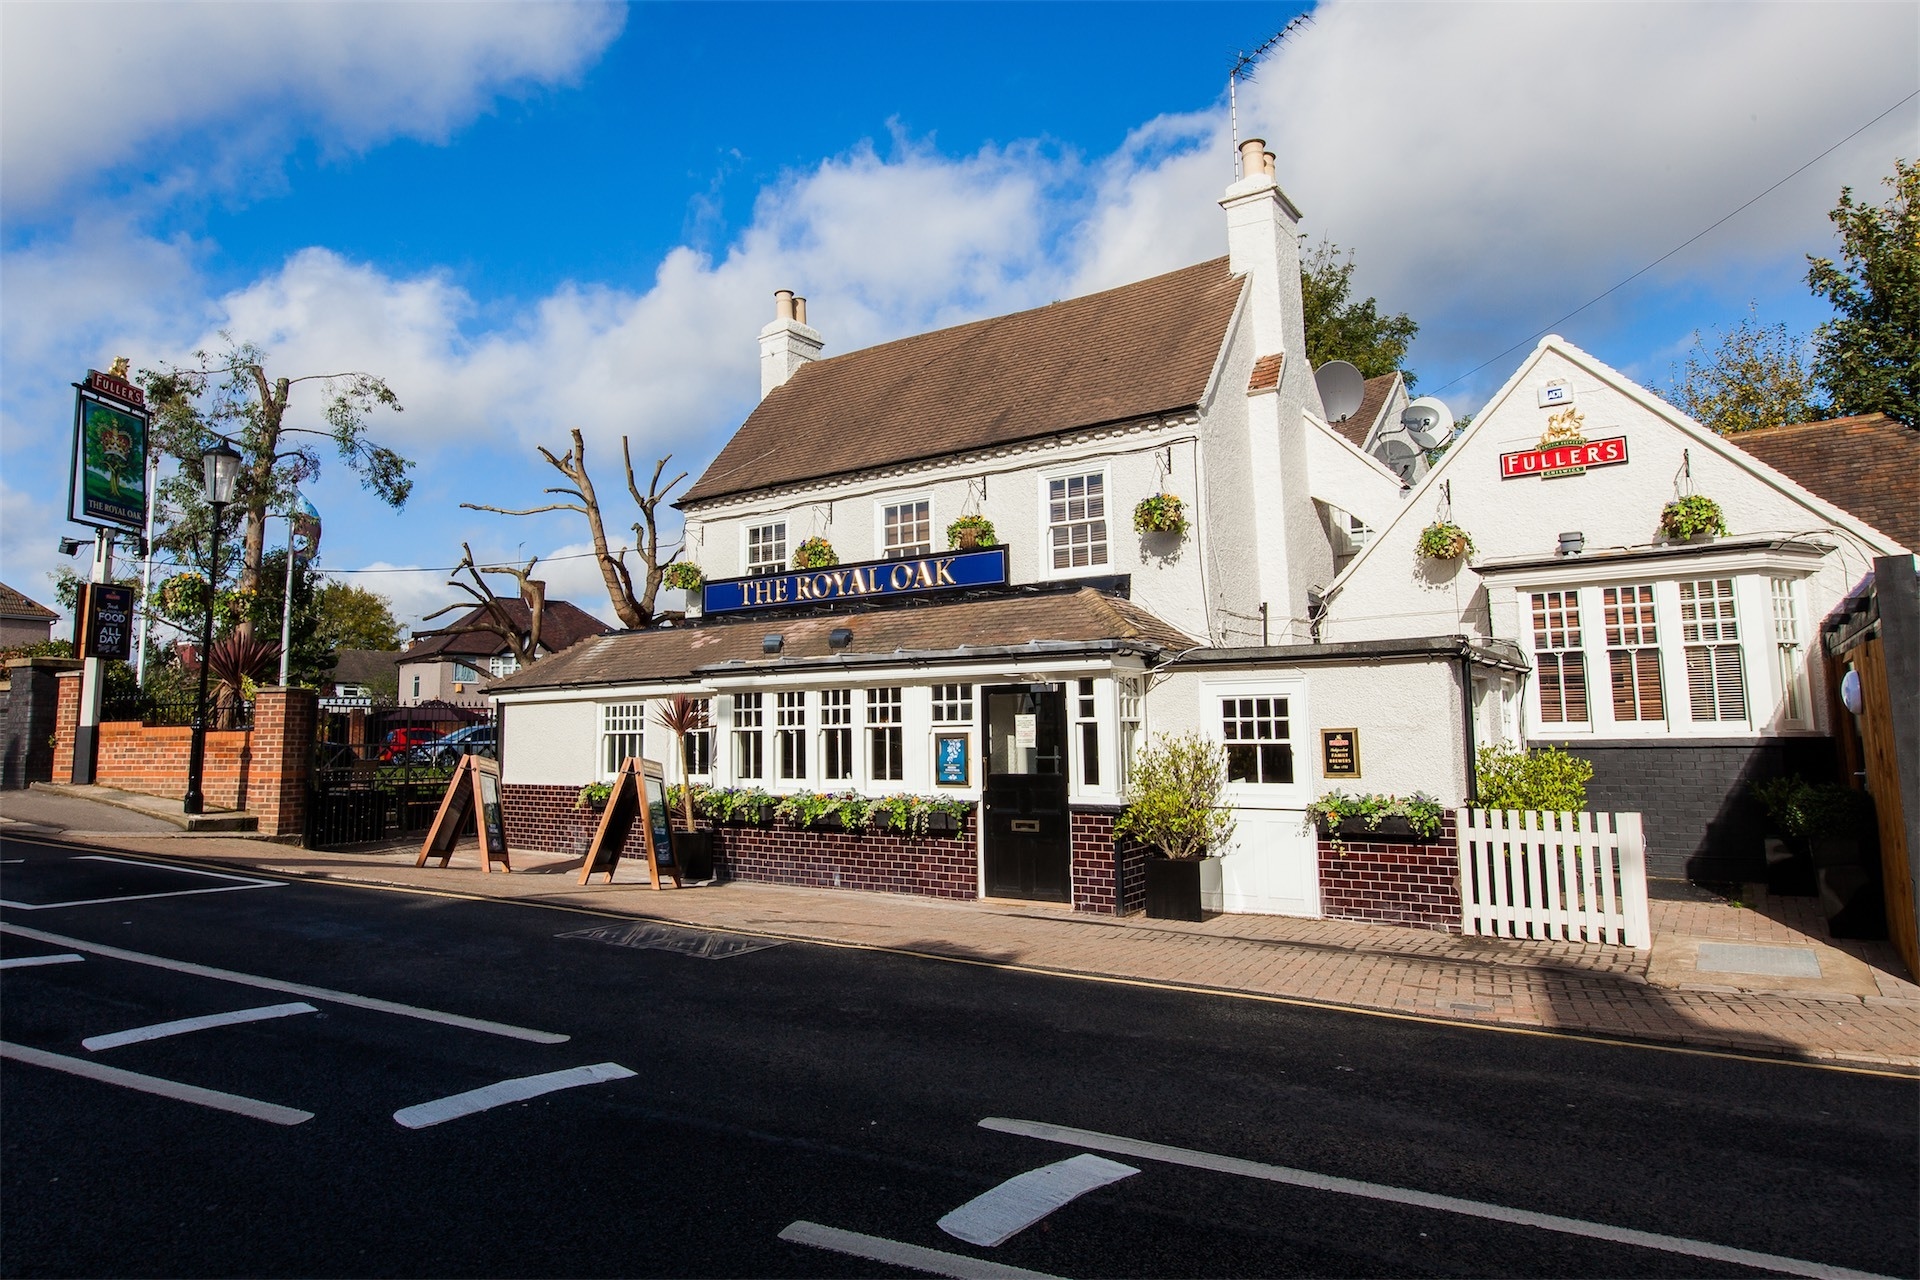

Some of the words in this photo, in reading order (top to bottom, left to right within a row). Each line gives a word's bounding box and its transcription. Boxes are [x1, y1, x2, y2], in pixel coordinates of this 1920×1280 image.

[96, 375, 141, 402] FULLER'S
[1508, 443, 1617, 472] FULLER'S
[88, 500, 104, 511] THE
[104, 503, 127, 517] ROYAL
[127, 509, 142, 520] OAK
[738, 578, 788, 606] THE
[795, 567, 883, 600] ROYAL
[890, 557, 957, 590] OAK
[99, 612, 125, 623] FOOD
[100, 627, 121, 636] ALL
[100, 635, 120, 644] DAY
